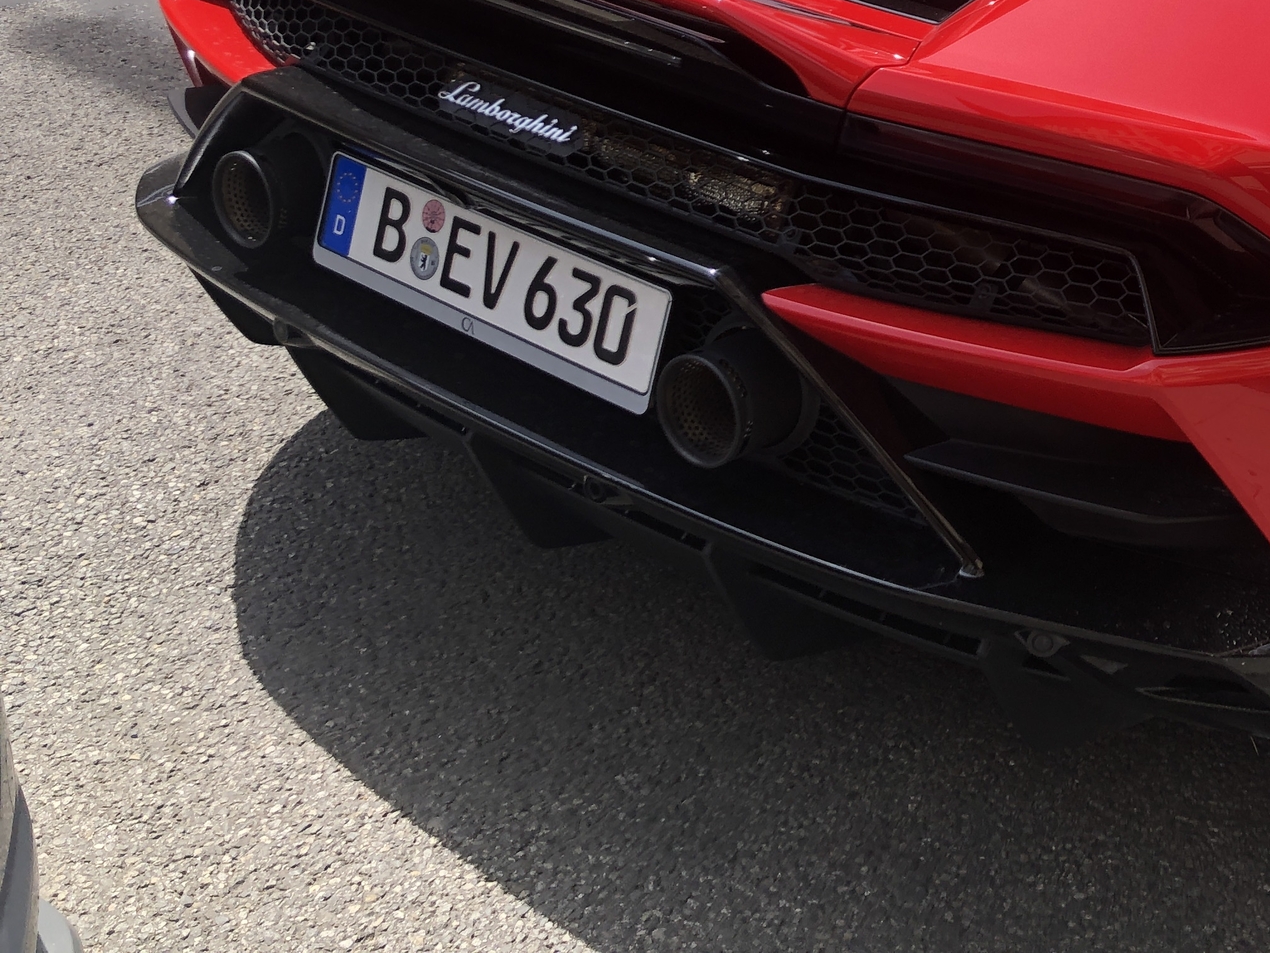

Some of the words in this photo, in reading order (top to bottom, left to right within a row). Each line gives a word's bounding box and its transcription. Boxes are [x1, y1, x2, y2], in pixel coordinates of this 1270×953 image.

[438, 81, 578, 143] Lamborghini
[332, 214, 346, 236] D
[373, 186, 411, 263] B
[439, 216, 520, 310] EV
[524, 256, 638, 366] 630
